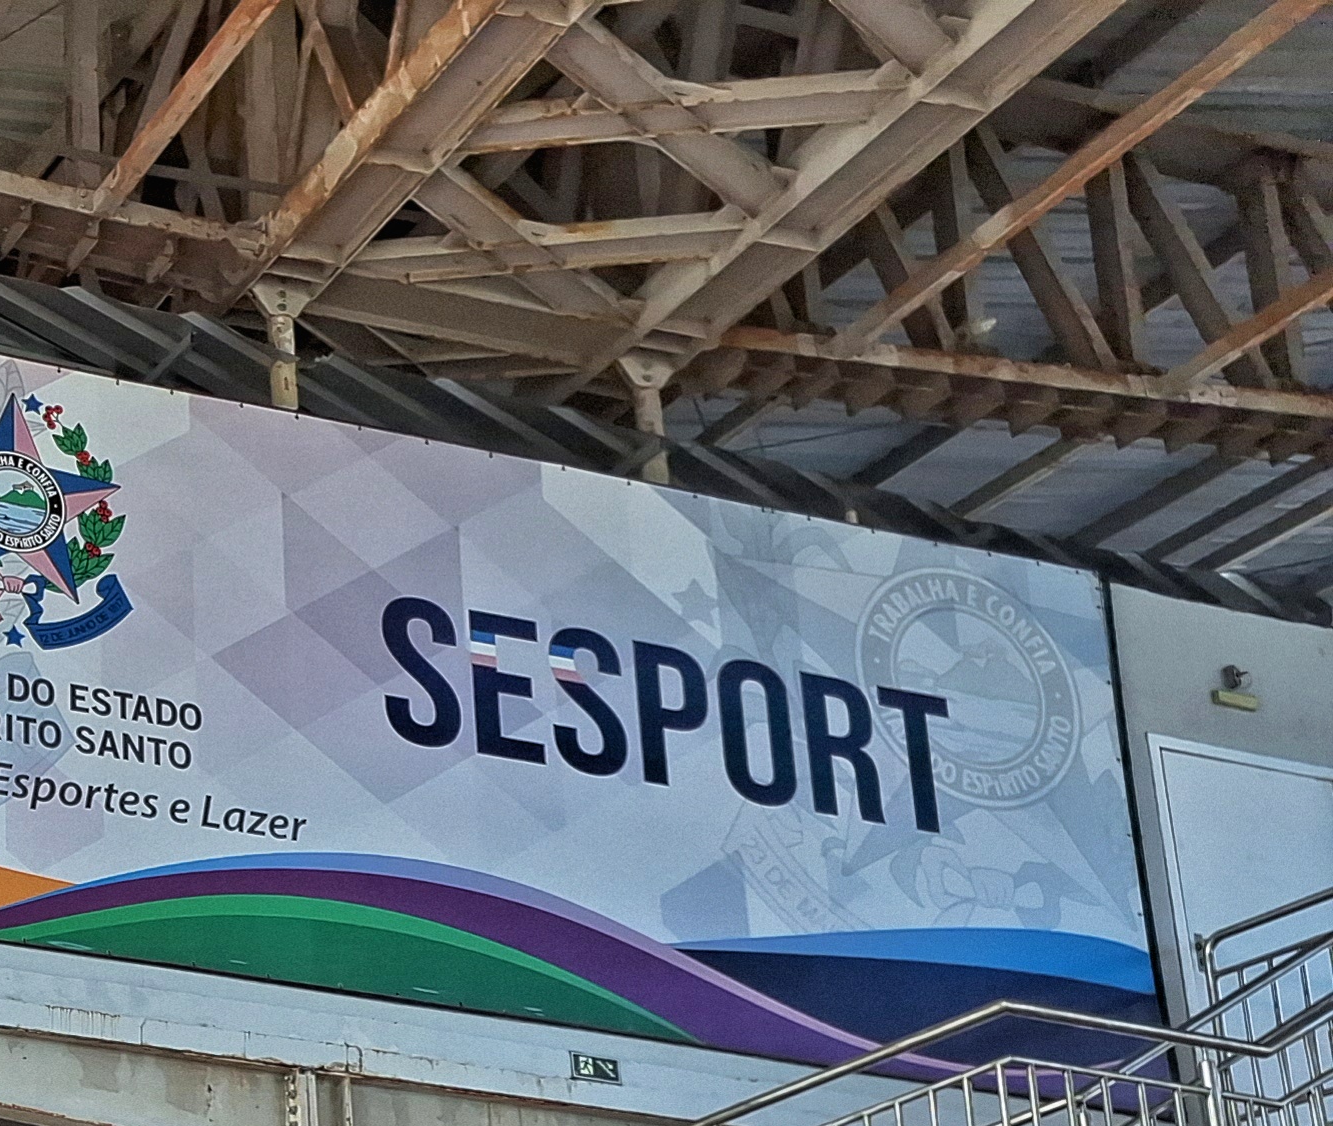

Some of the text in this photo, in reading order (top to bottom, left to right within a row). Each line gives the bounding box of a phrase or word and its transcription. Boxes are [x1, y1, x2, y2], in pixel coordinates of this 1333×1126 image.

[17, 459, 24, 469] E
[25, 463, 57, 498] CONFIA
[40, 513, 60, 540] SANTO
[869, 579, 1056, 674] TRABALHA E CONFIA
[7, 672, 55, 707] DO
[69, 683, 202, 732] ESTADO
[380, 596, 949, 833] SESPORT
[74, 726, 192, 770] SANTO
[169, 798, 191, 824] e
[200, 795, 307, 842] Lazer
